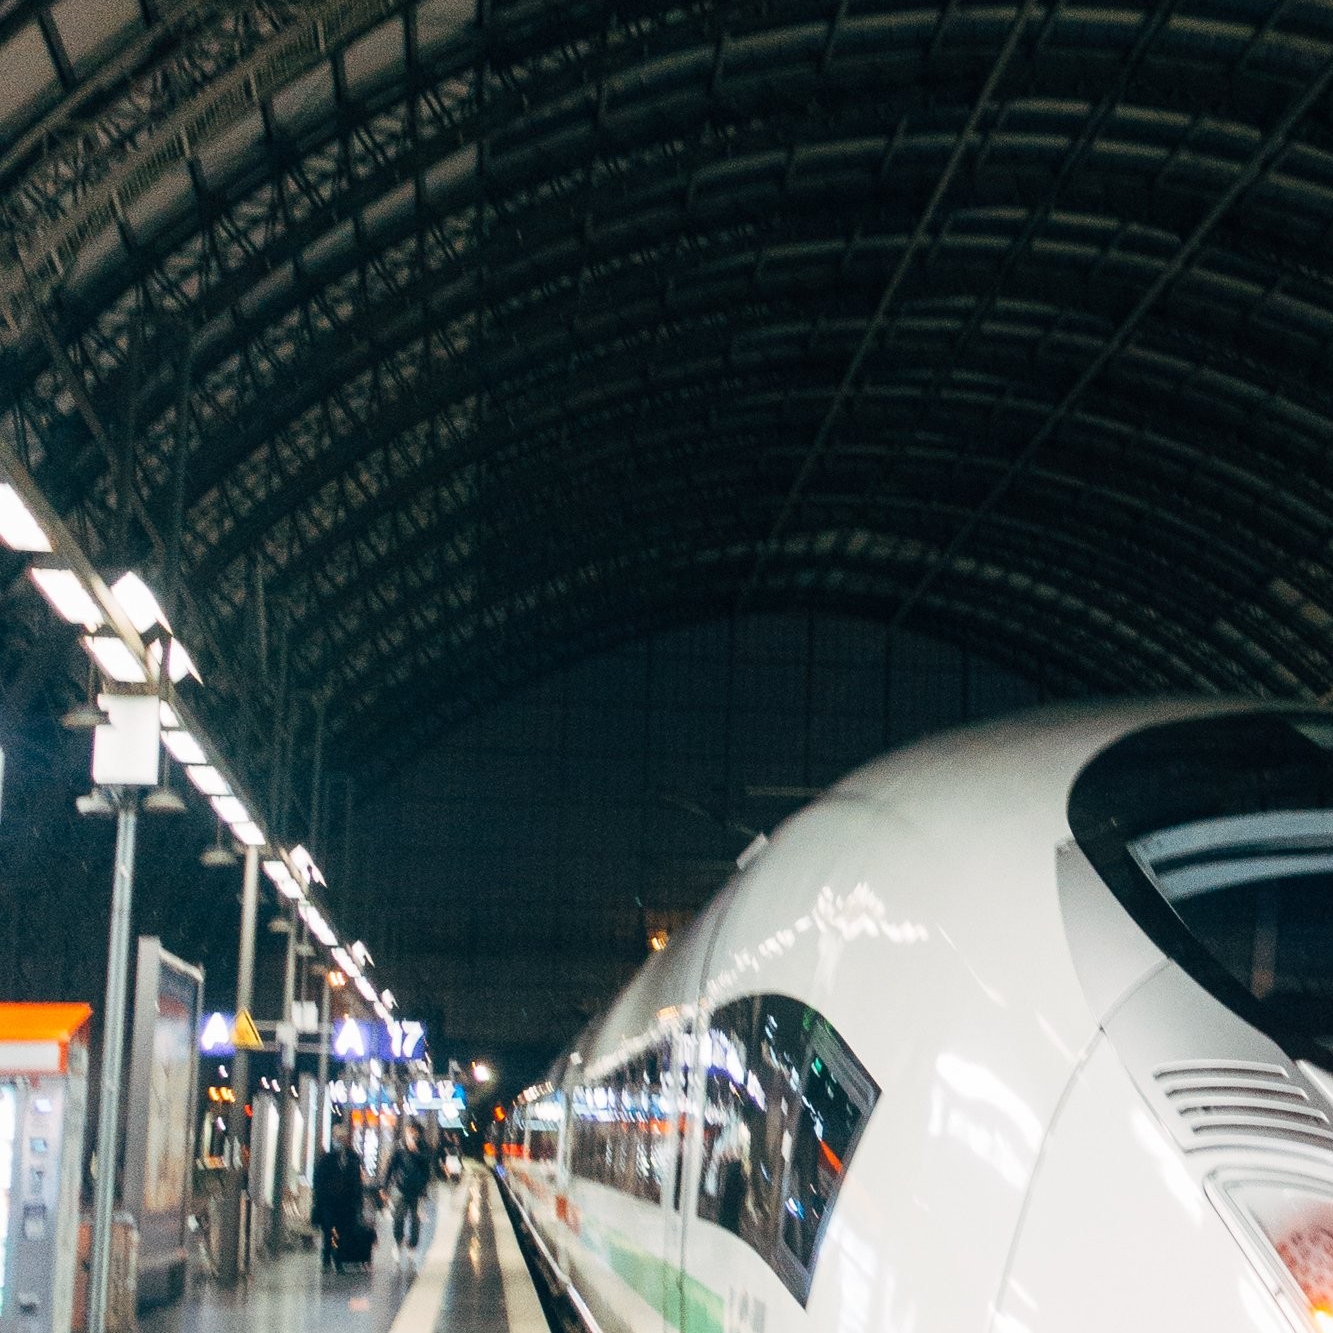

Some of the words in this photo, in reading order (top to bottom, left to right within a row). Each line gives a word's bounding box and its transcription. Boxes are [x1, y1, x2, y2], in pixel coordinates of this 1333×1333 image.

[201, 1012, 230, 1051] A
[335, 1018, 365, 1057] A
[389, 1019, 425, 1058] 17
